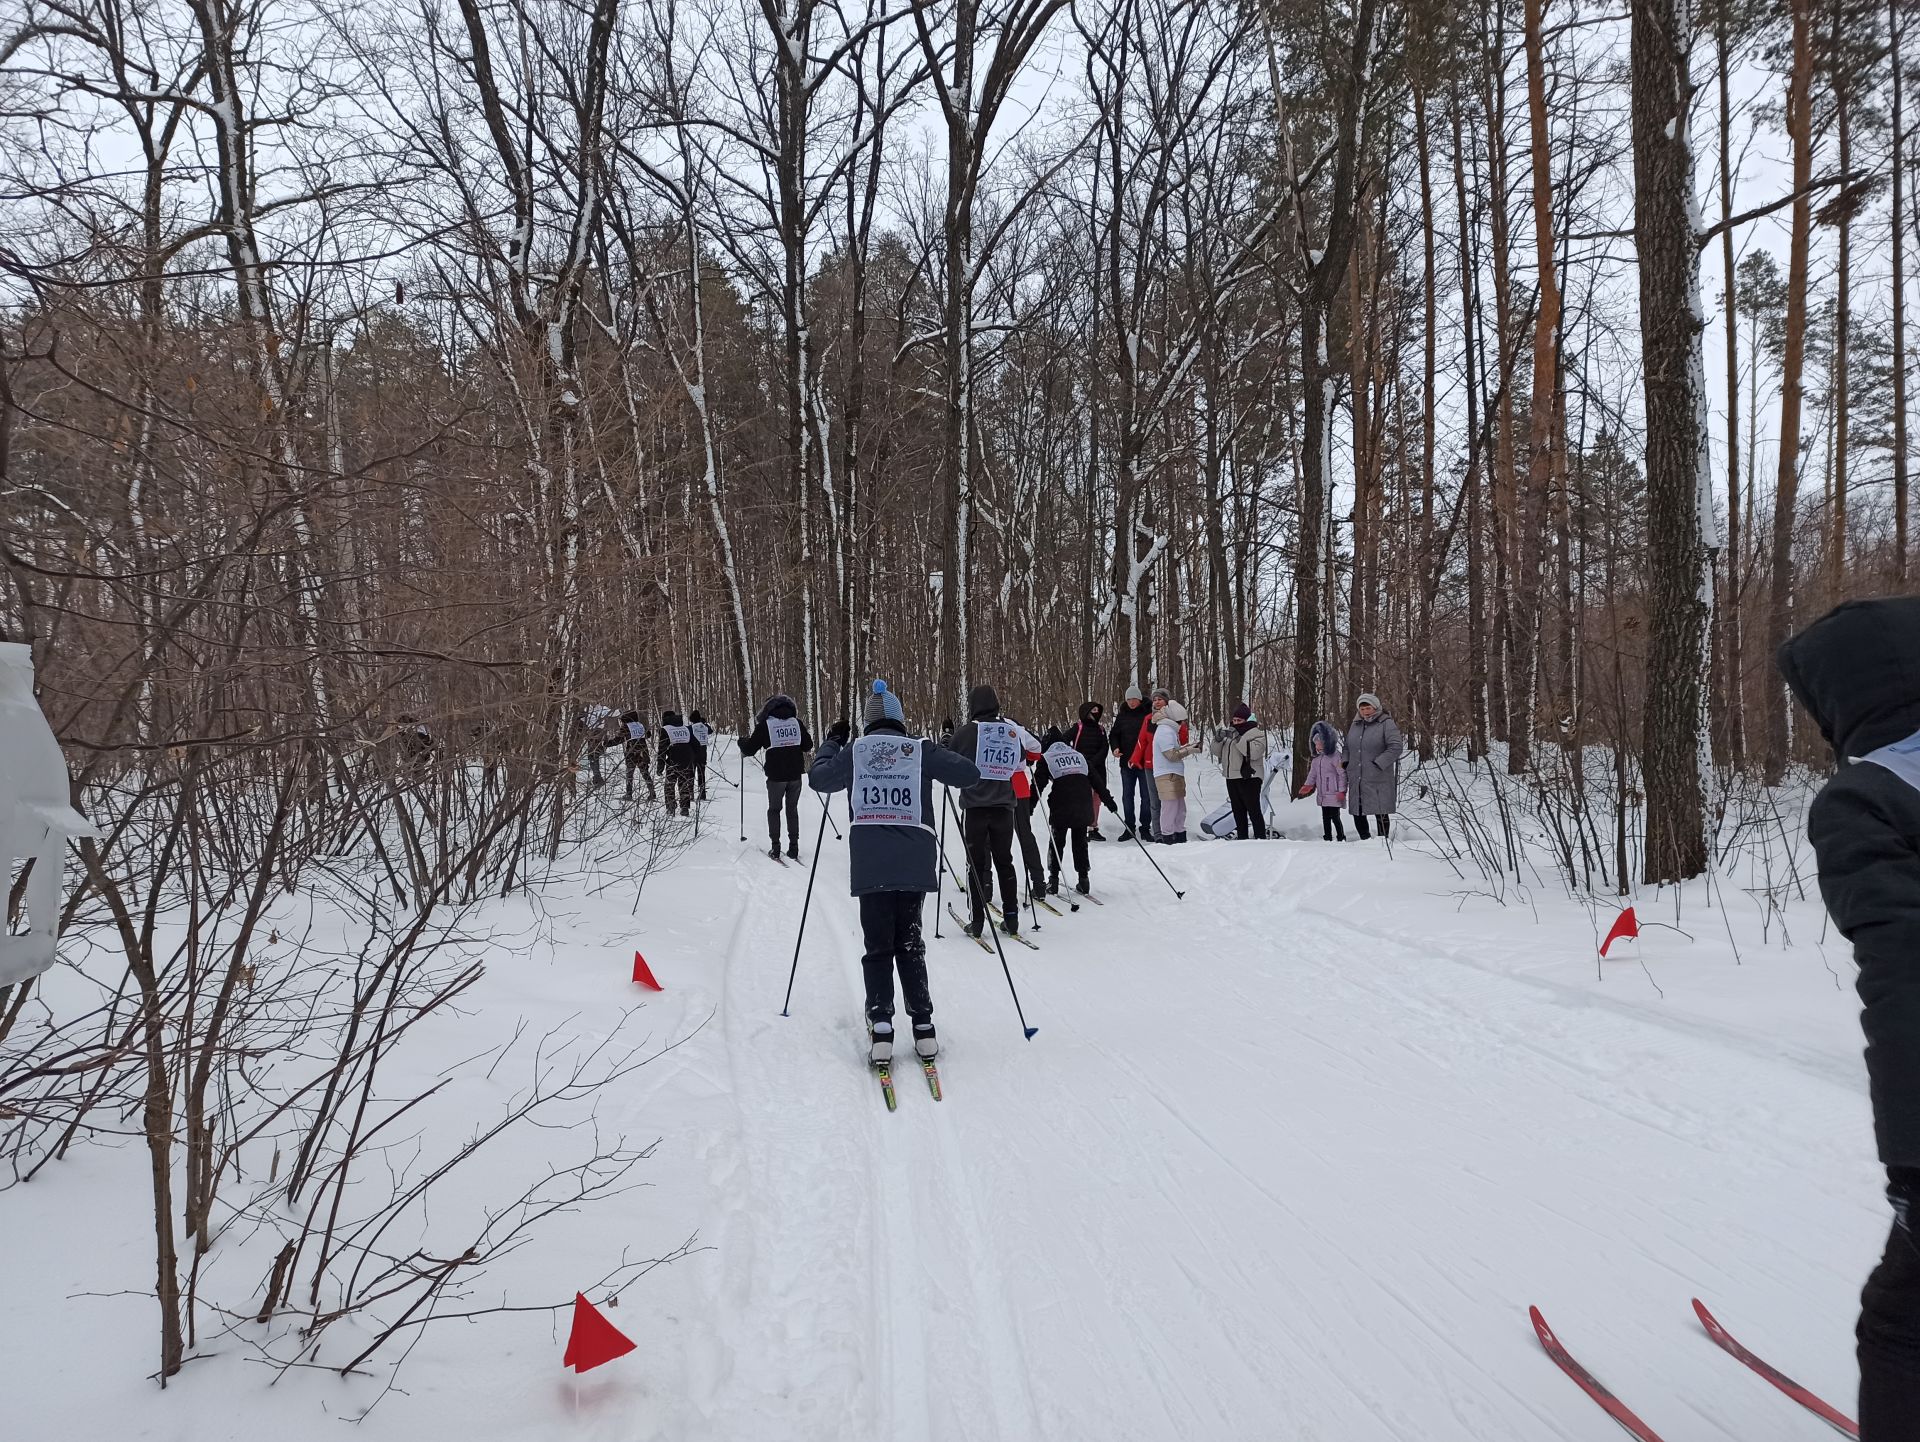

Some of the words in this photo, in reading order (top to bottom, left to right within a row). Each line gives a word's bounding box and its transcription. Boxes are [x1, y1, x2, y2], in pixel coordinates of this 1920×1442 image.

[983, 748, 1015, 765] 17451
[1055, 755, 1081, 768] 19014
[862, 786, 912, 806] 13108
